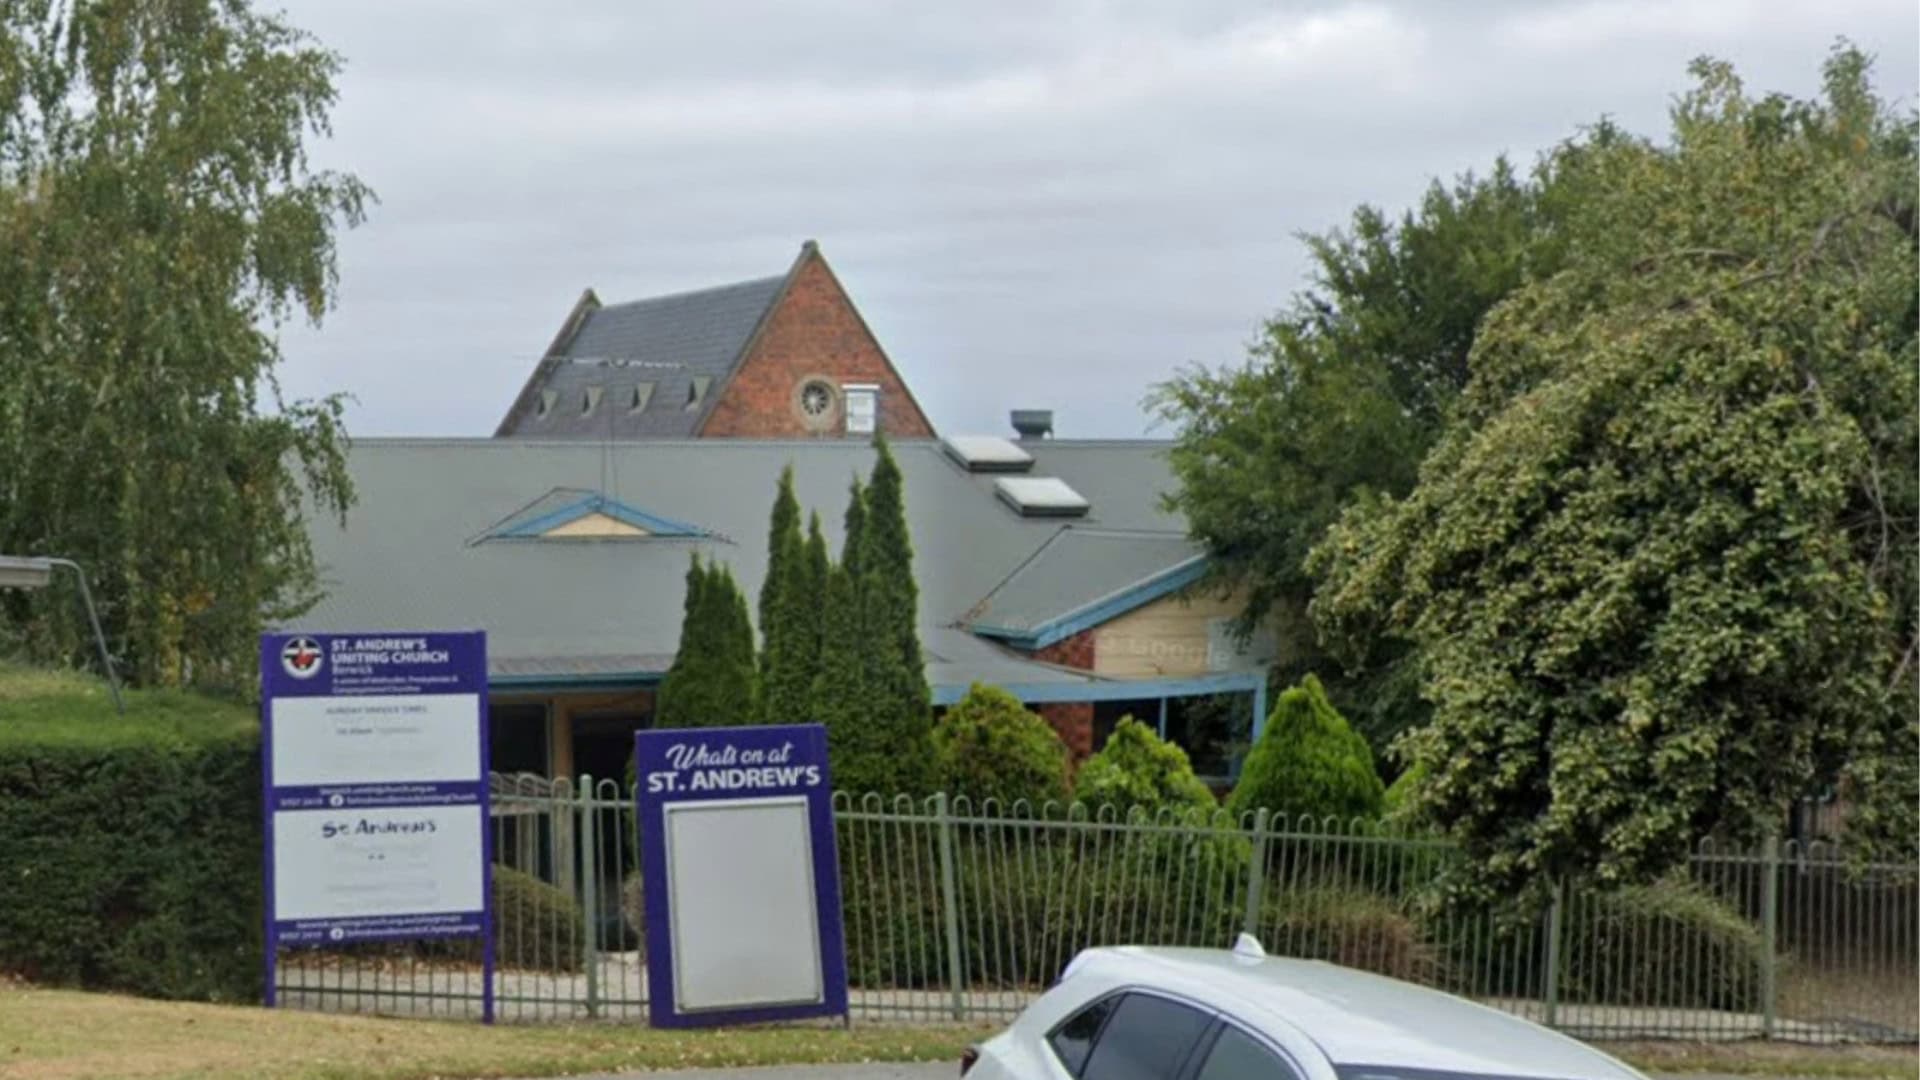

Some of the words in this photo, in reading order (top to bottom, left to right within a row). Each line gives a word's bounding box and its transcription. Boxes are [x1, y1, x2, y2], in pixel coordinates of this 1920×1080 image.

[331, 639, 353, 651] ST.
[355, 637, 427, 651] ANDREW'S
[331, 652, 389, 665] UNITING
[391, 651, 449, 664] CHURCH
[331, 665, 374, 676] Berwick
[740, 748, 765, 765] on
[767, 740, 795, 762] at
[647, 771, 685, 792] ST.
[690, 766, 821, 790] ANDREW'S
